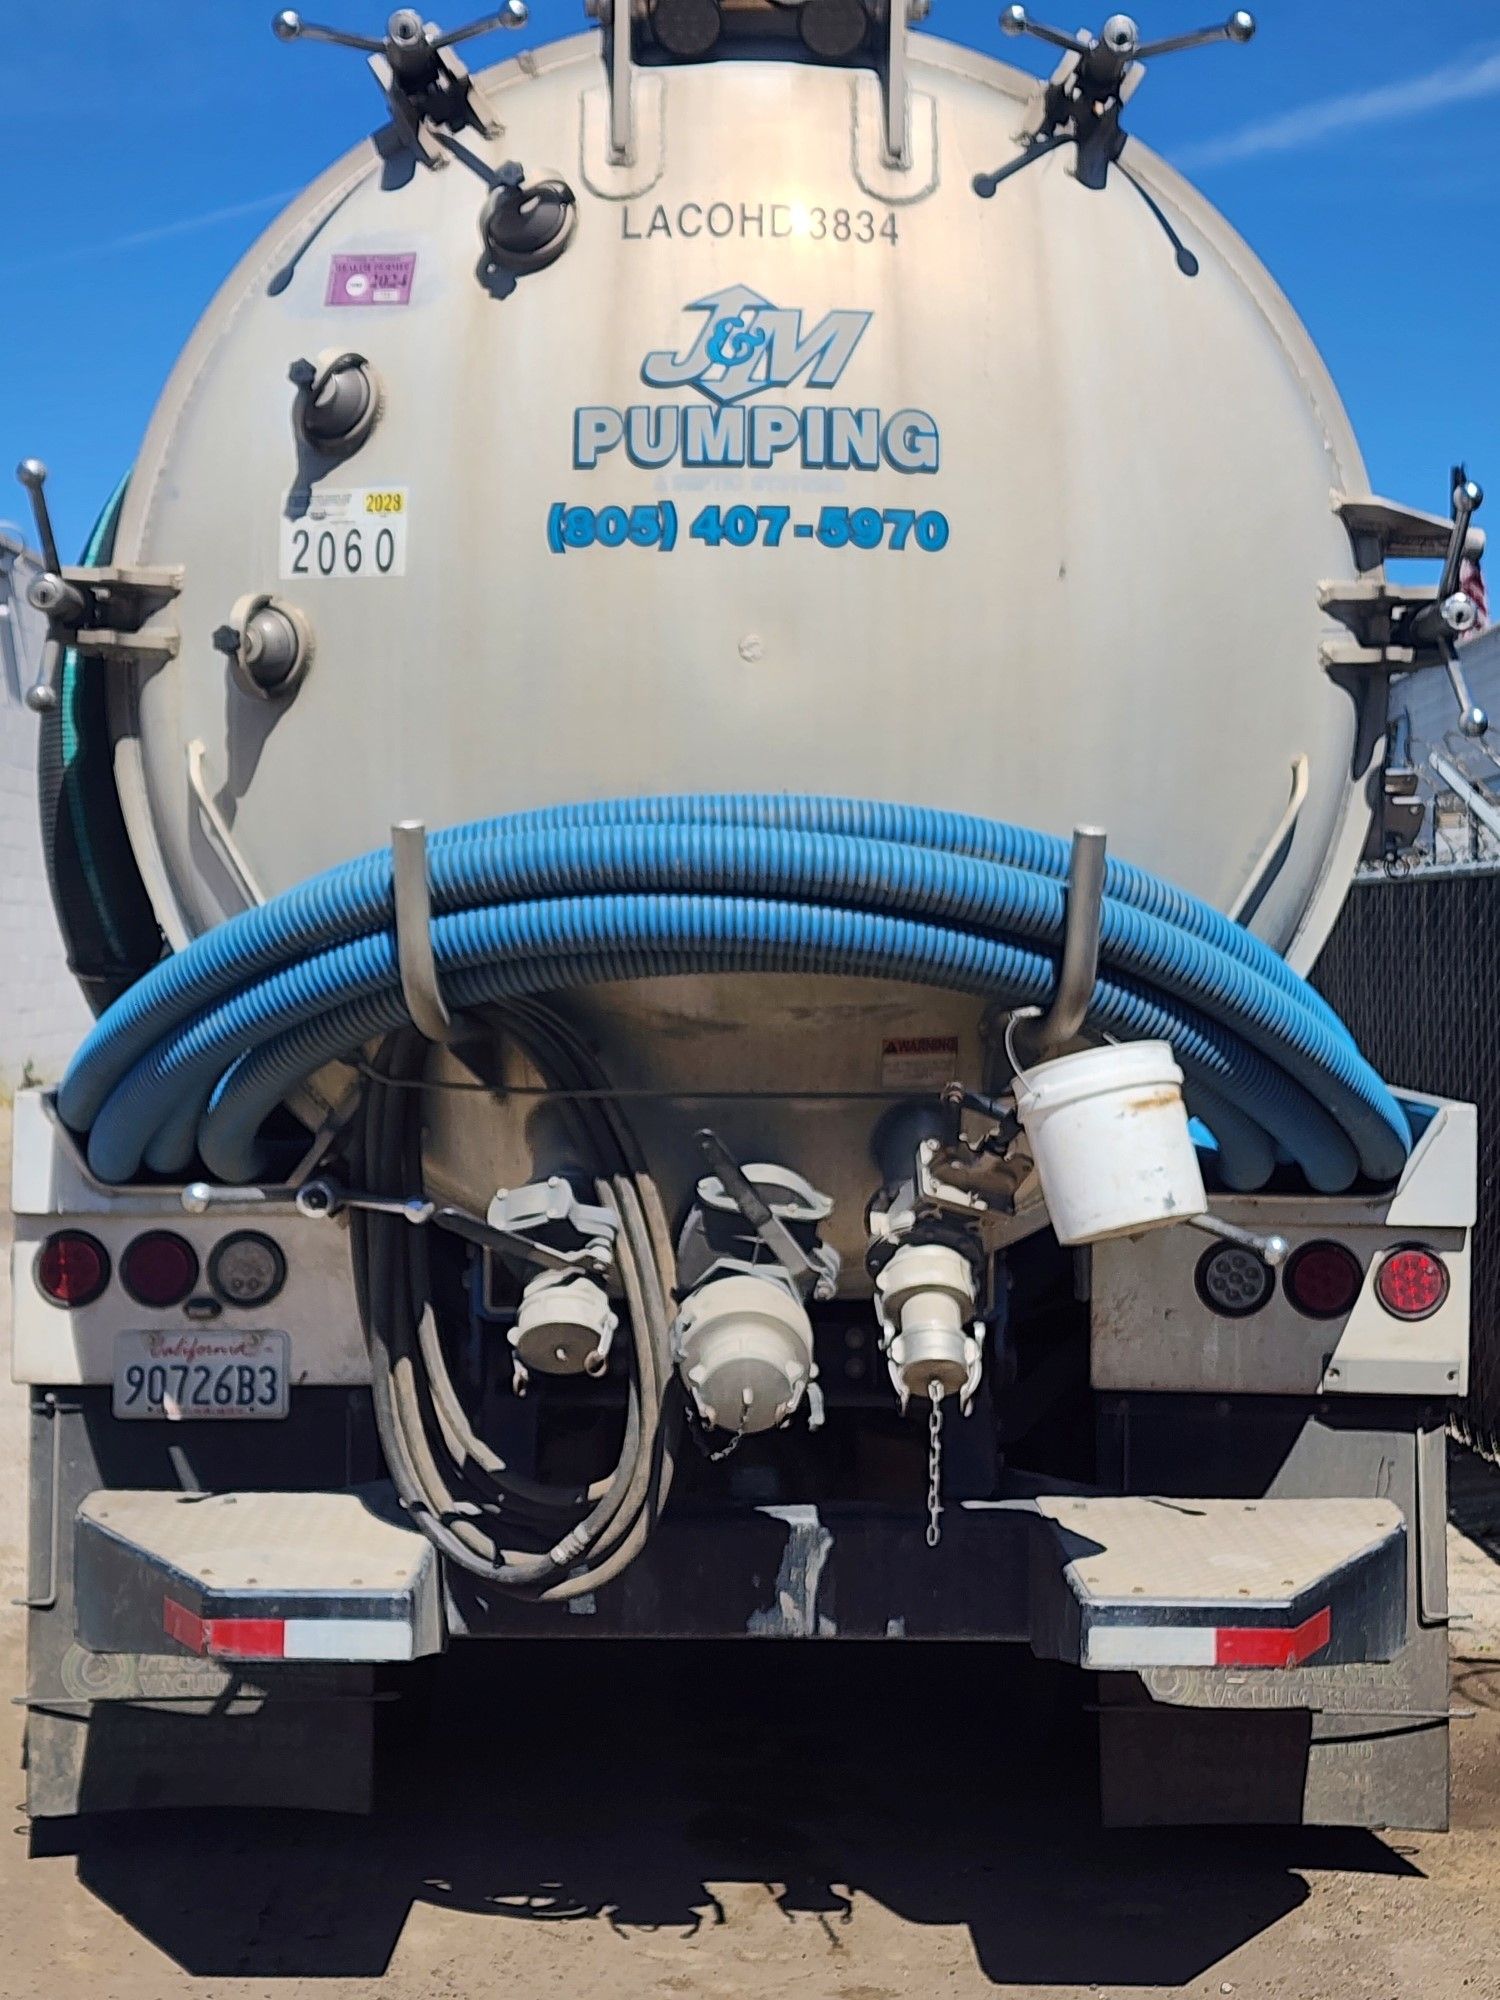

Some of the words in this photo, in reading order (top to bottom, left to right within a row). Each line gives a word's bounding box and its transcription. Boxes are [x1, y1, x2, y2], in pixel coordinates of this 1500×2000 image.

[621, 202, 792, 240] LACOHD
[810, 207, 898, 247] 3834
[642, 285, 874, 402] J&M
[573, 405, 939, 473] PUMPING
[547, 500, 678, 553] (805)
[689, 505, 949, 552] 407-5970
[292, 528, 394, 575] 2060
[150, 1337, 257, 1363] California
[124, 1364, 278, 1406] 90726B3
